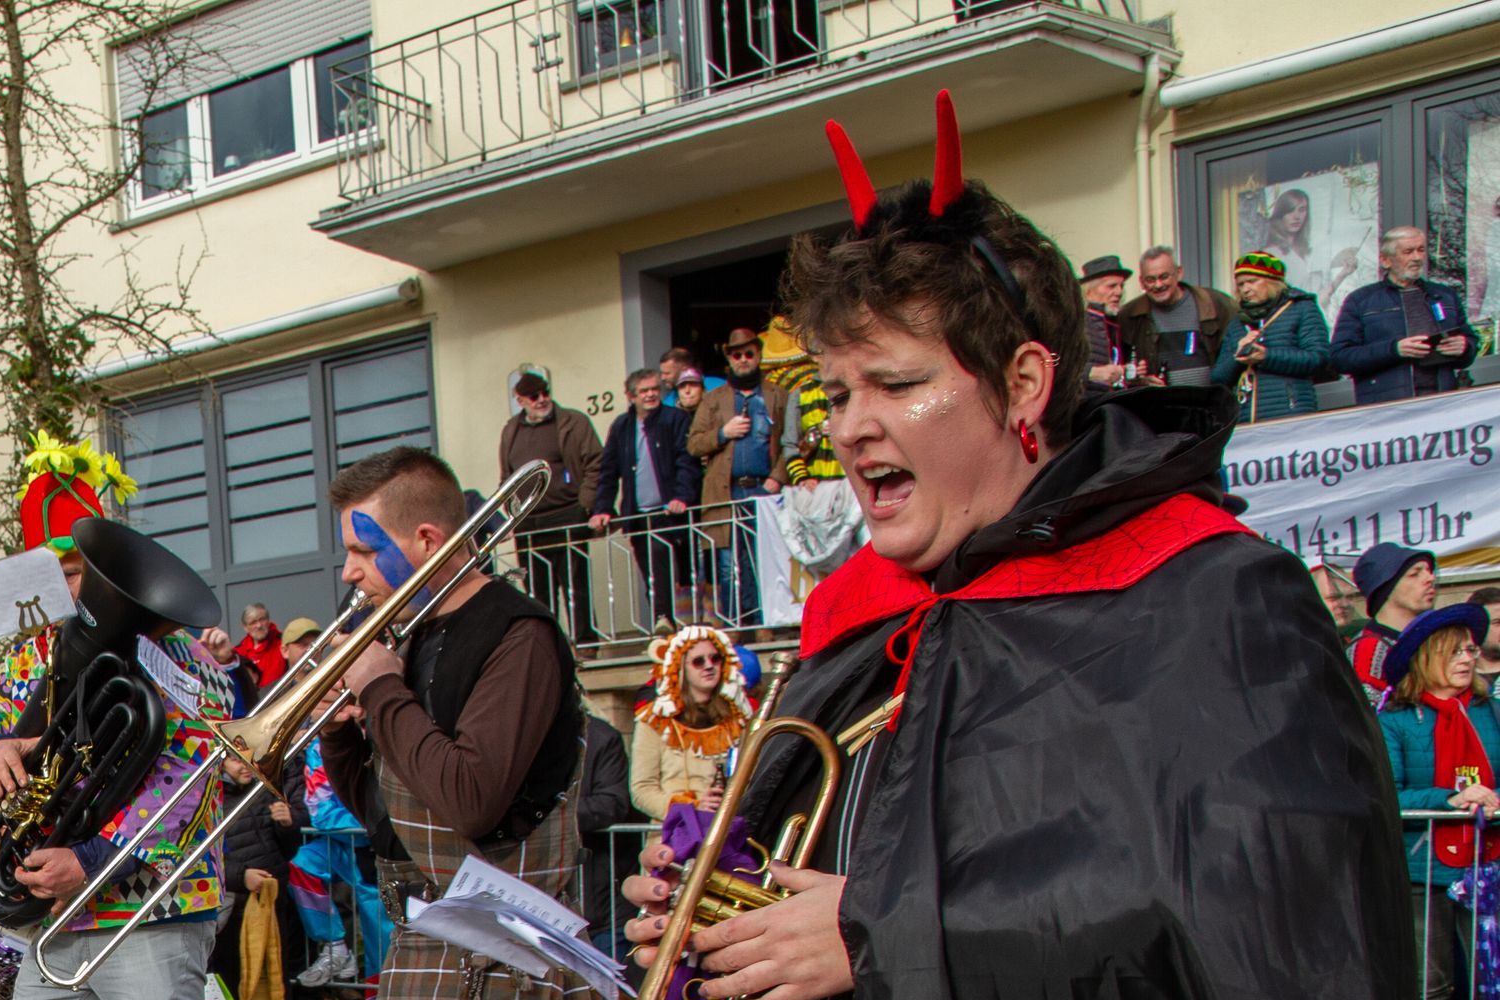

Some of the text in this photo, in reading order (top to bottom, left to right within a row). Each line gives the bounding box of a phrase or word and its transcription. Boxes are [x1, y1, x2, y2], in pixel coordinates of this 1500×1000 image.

[587, 391, 615, 416] 32
[1286, 501, 1473, 559] 14:11 Uhr
